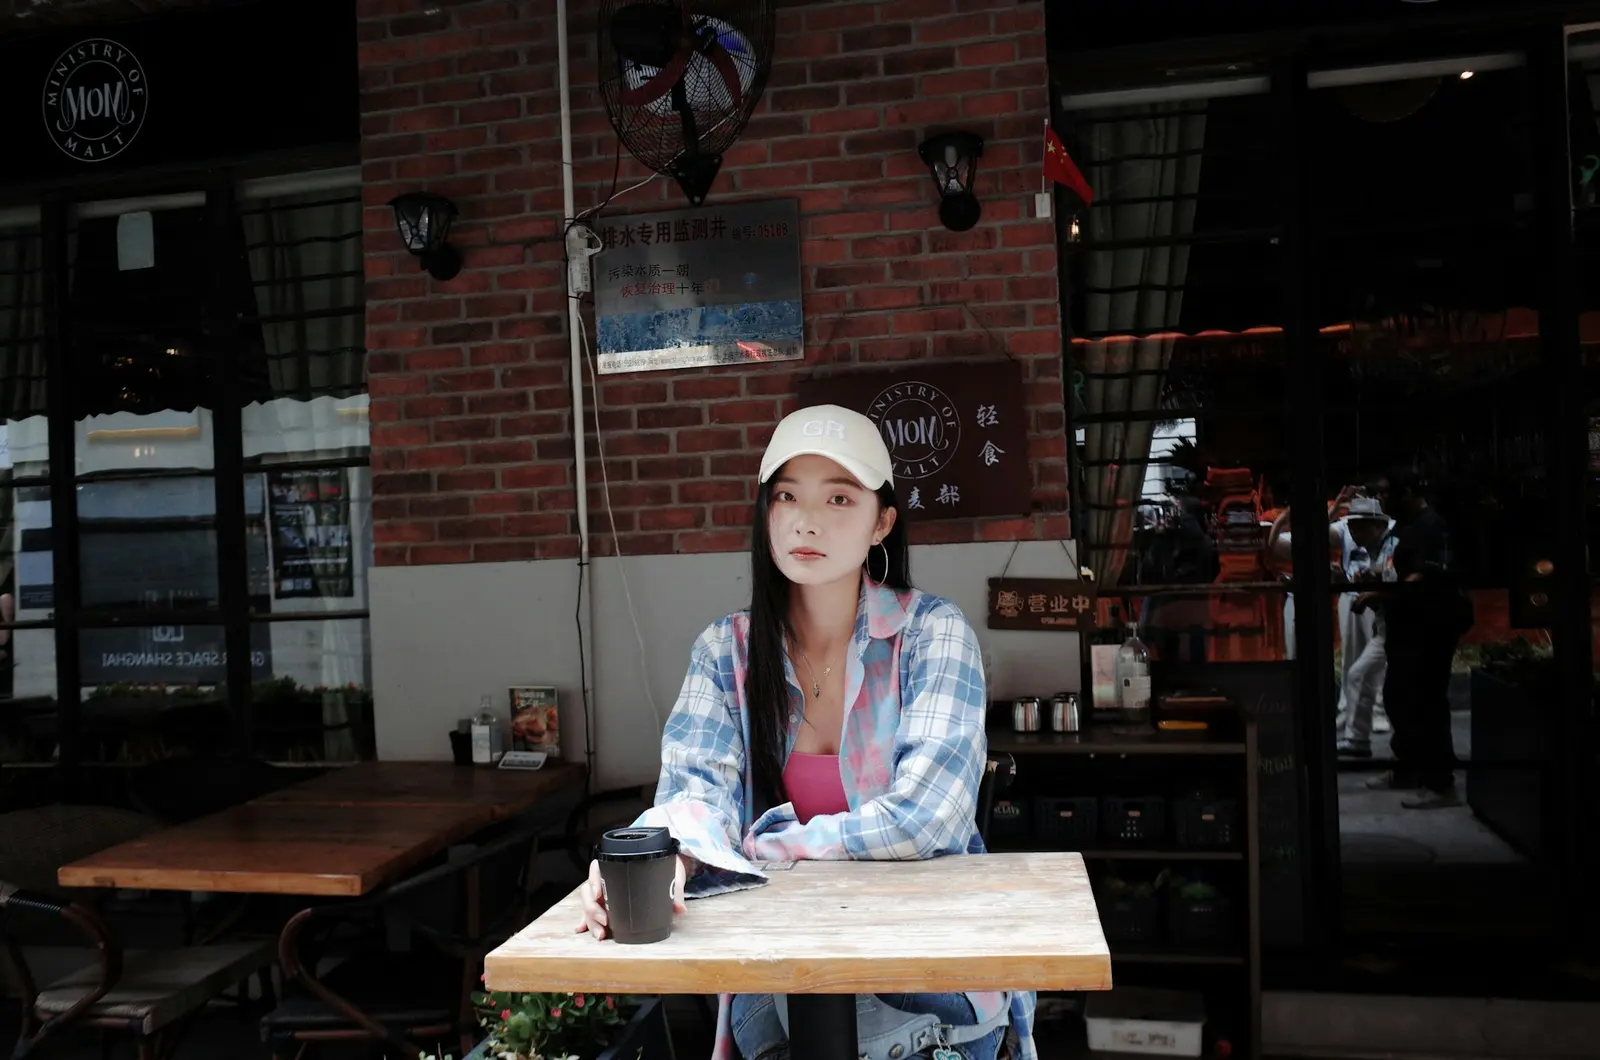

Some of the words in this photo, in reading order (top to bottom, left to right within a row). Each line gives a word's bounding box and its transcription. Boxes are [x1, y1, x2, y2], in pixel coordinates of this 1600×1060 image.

[47, 43, 127, 106] MINISTRY
[128, 69, 145, 96] OF
[64, 132, 124, 157] MALT
[602, 215, 727, 250] 排水专用监测井
[608, 264, 690, 282] 污染水质一朝
[869, 385, 940, 419] INISTRY
[941, 406, 957, 428] OF
[802, 420, 846, 440] GR
[976, 404, 1006, 467] 轻食
[1028, 593, 1091, 614] 营业中
